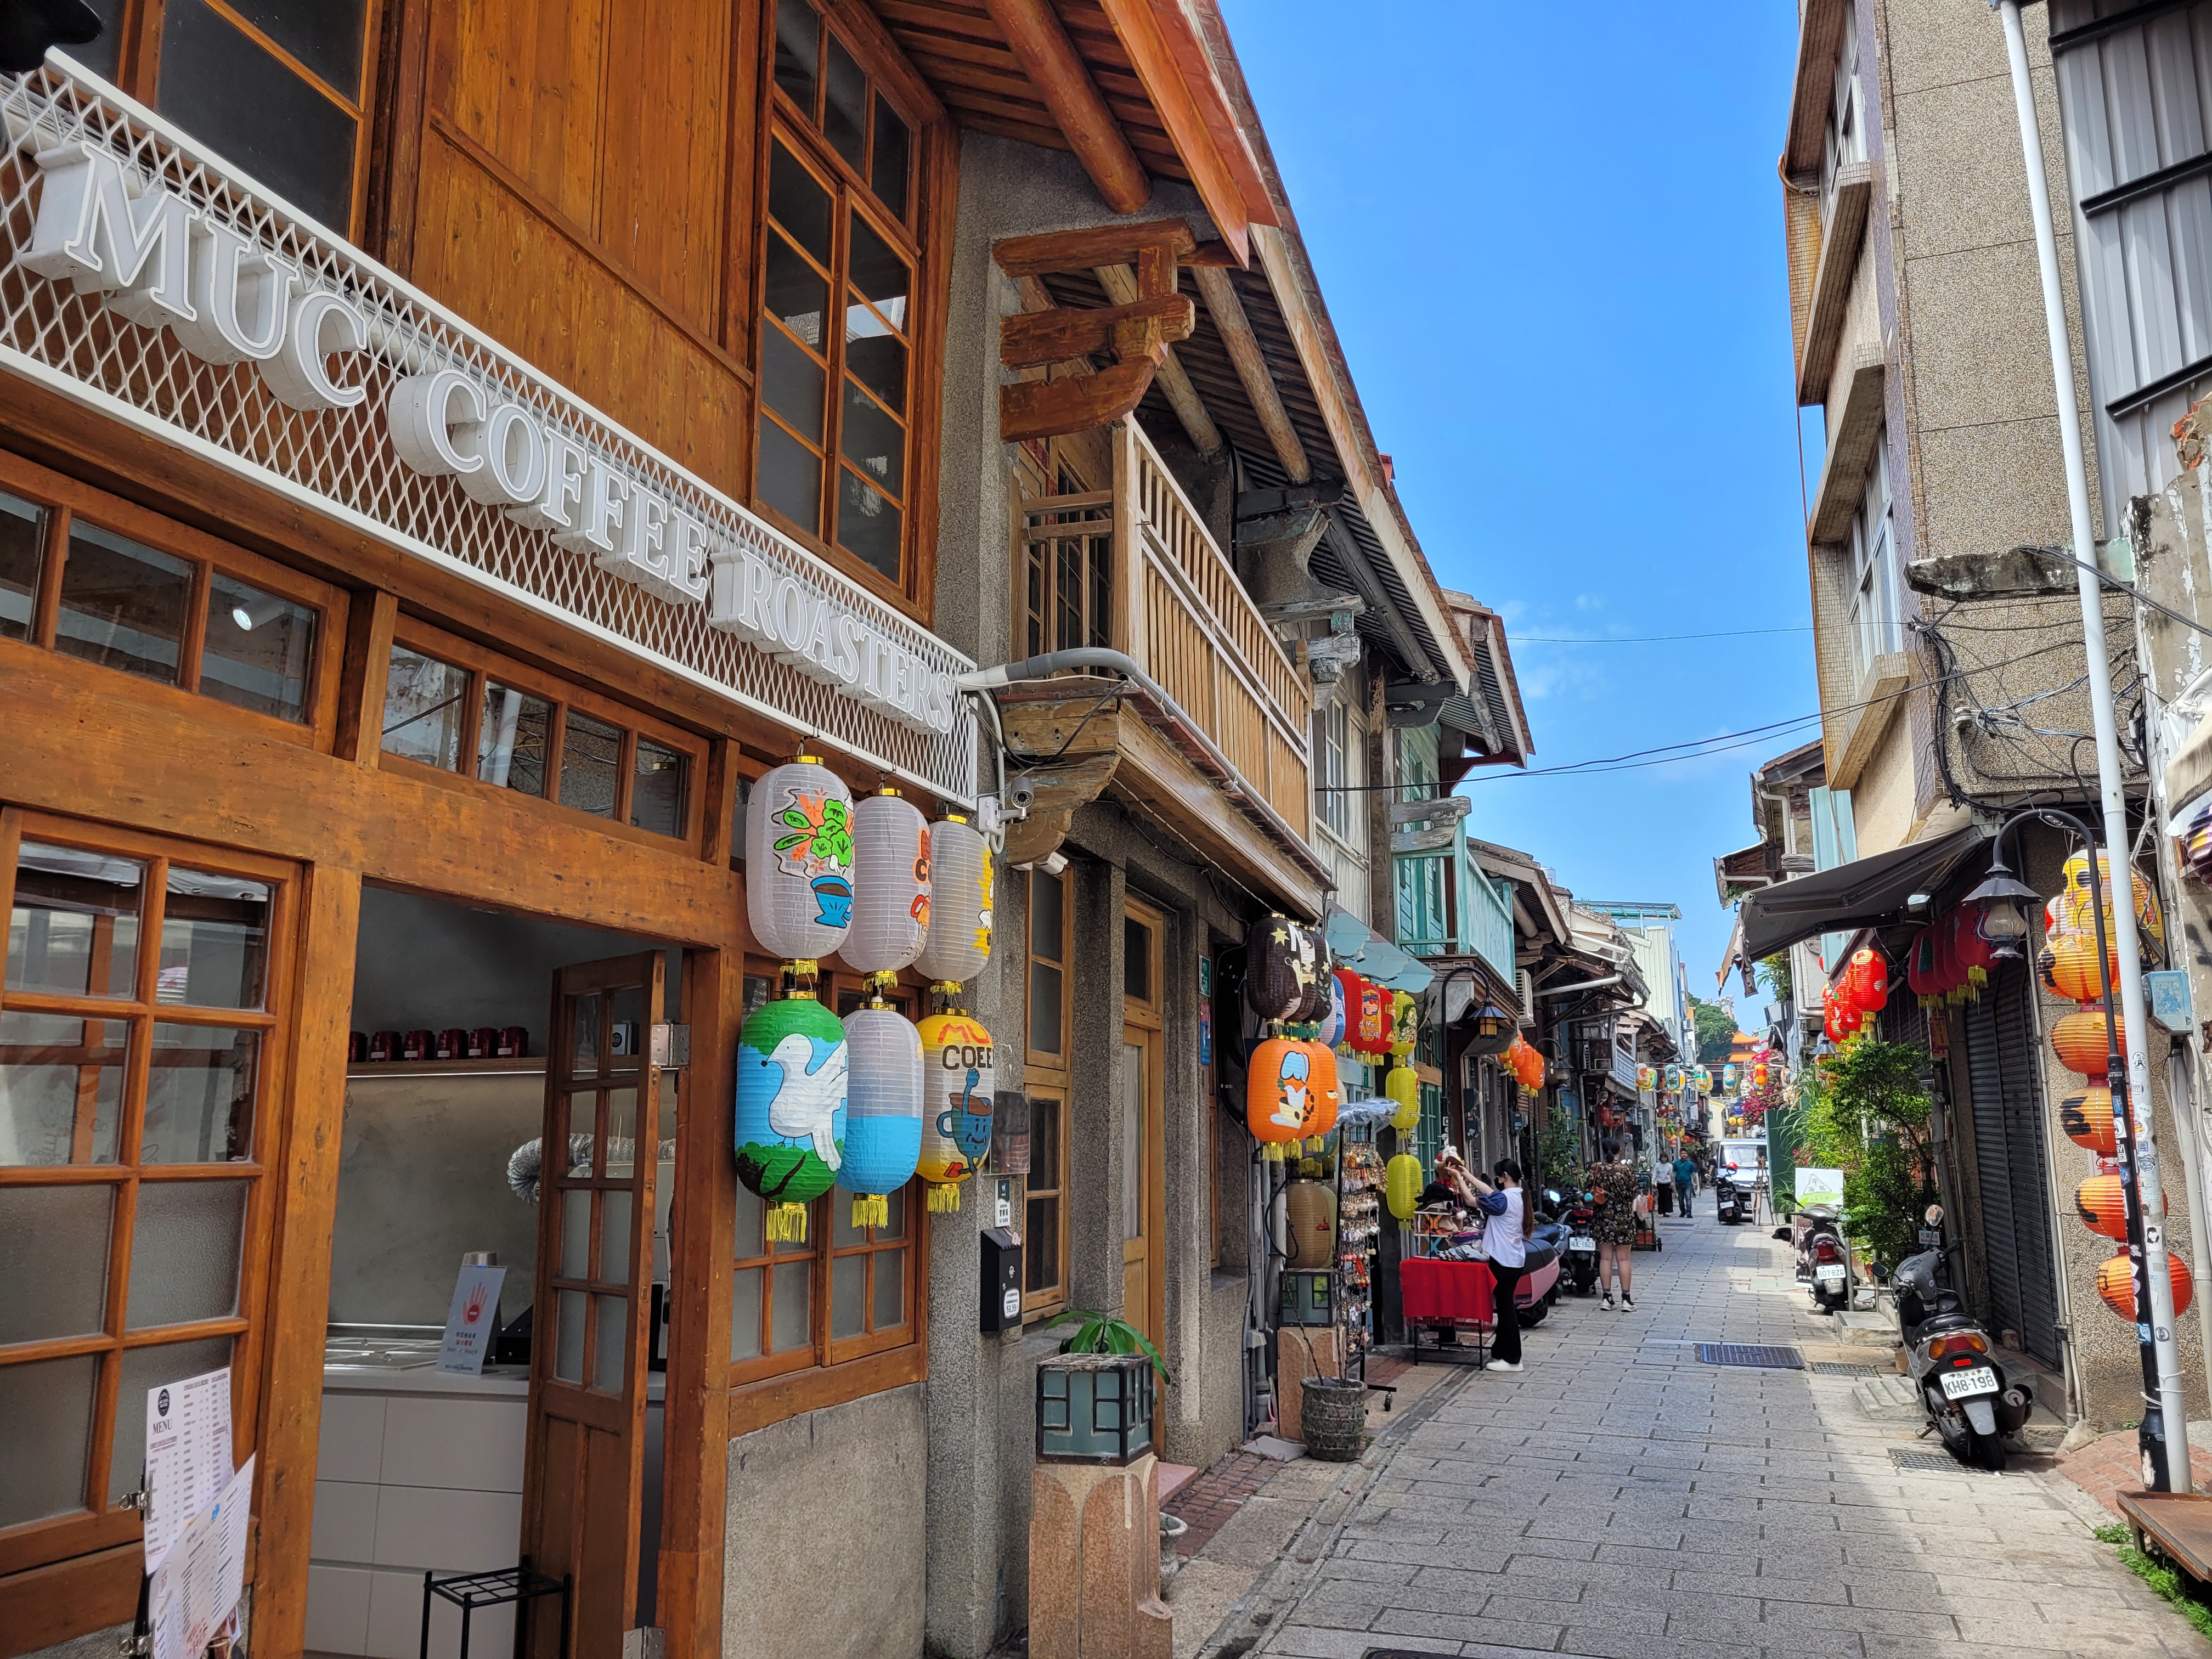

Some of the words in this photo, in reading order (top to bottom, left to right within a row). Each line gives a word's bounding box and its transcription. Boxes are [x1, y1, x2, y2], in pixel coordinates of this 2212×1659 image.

[64, 139, 367, 409] MUC
[427, 369, 708, 603] COFFEE
[737, 548, 953, 734] ROASTERS
[1944, 1375, 1995, 1396] KH8-198
[152, 1418, 173, 1435] MENU
